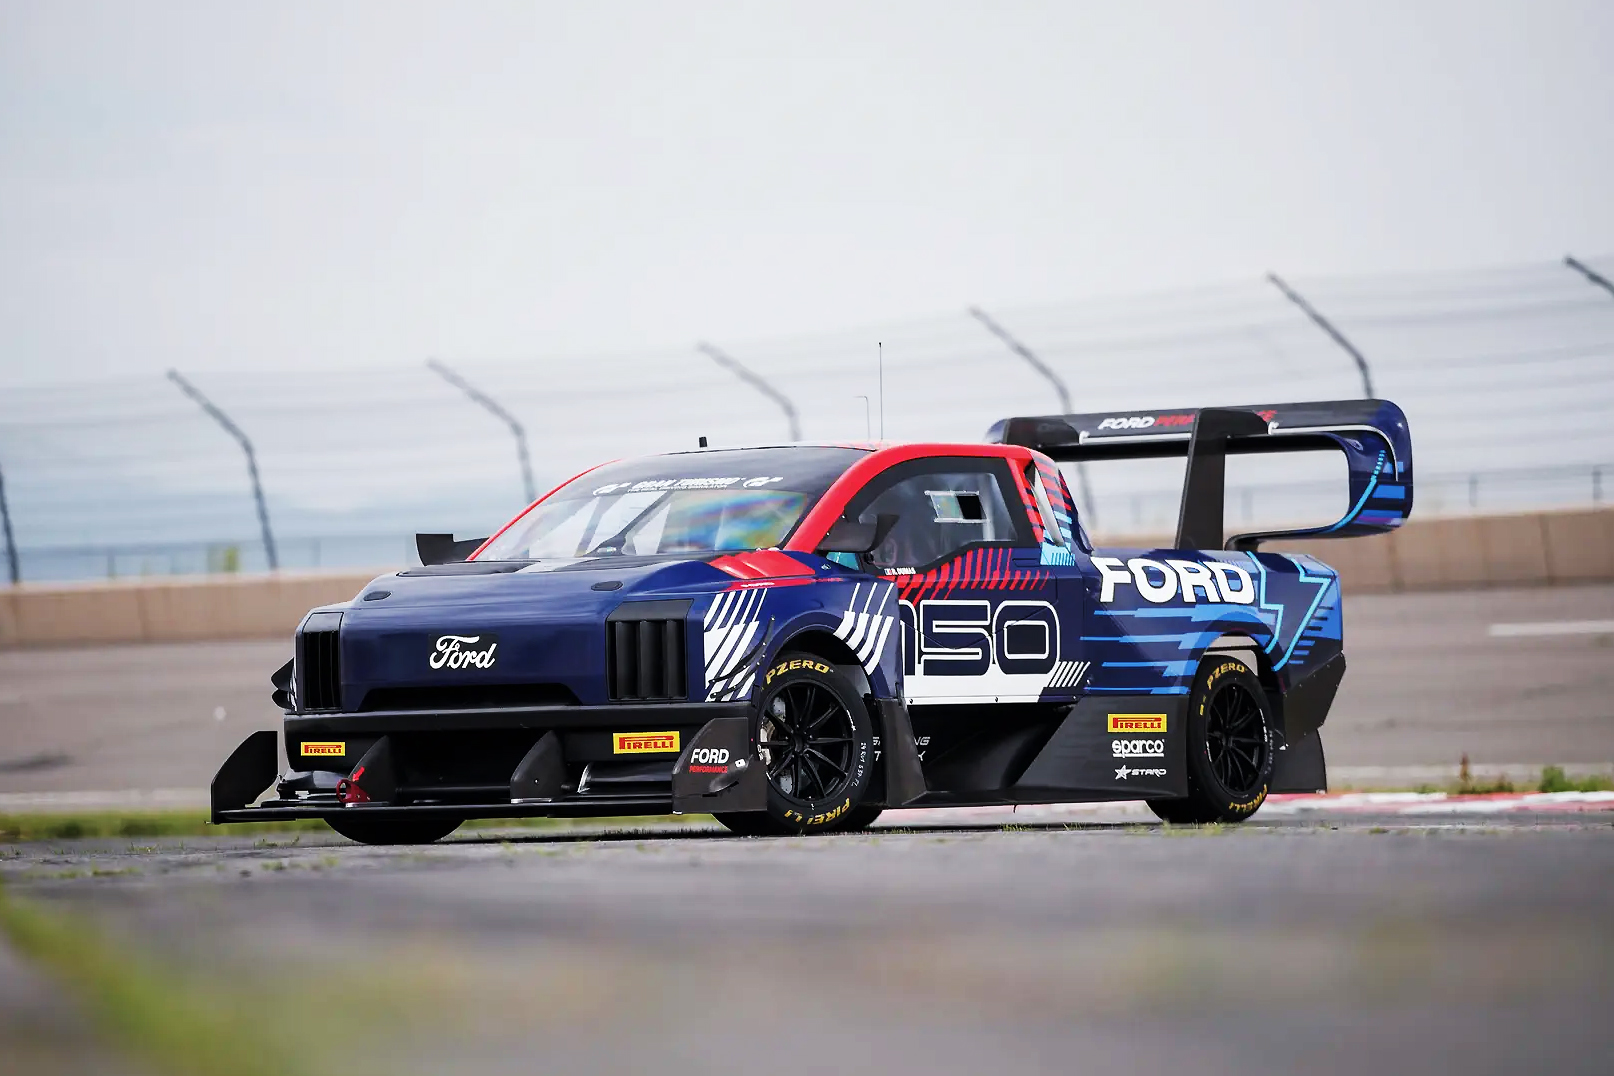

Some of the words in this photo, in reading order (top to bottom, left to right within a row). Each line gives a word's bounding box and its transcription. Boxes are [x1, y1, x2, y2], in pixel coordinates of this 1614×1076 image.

[1098, 416, 1155, 430] FORD
[1092, 556, 1255, 604] FORD
[429, 635, 498, 669] Ford
[1112, 717, 1162, 729] PIRELLI
[304, 744, 343, 754] PIRELLI
[618, 735, 674, 750] PIRELLI
[1112, 739, 1164, 758] sparco
[690, 748, 729, 764] FORD
[689, 765, 728, 773] PERFORMANCE
